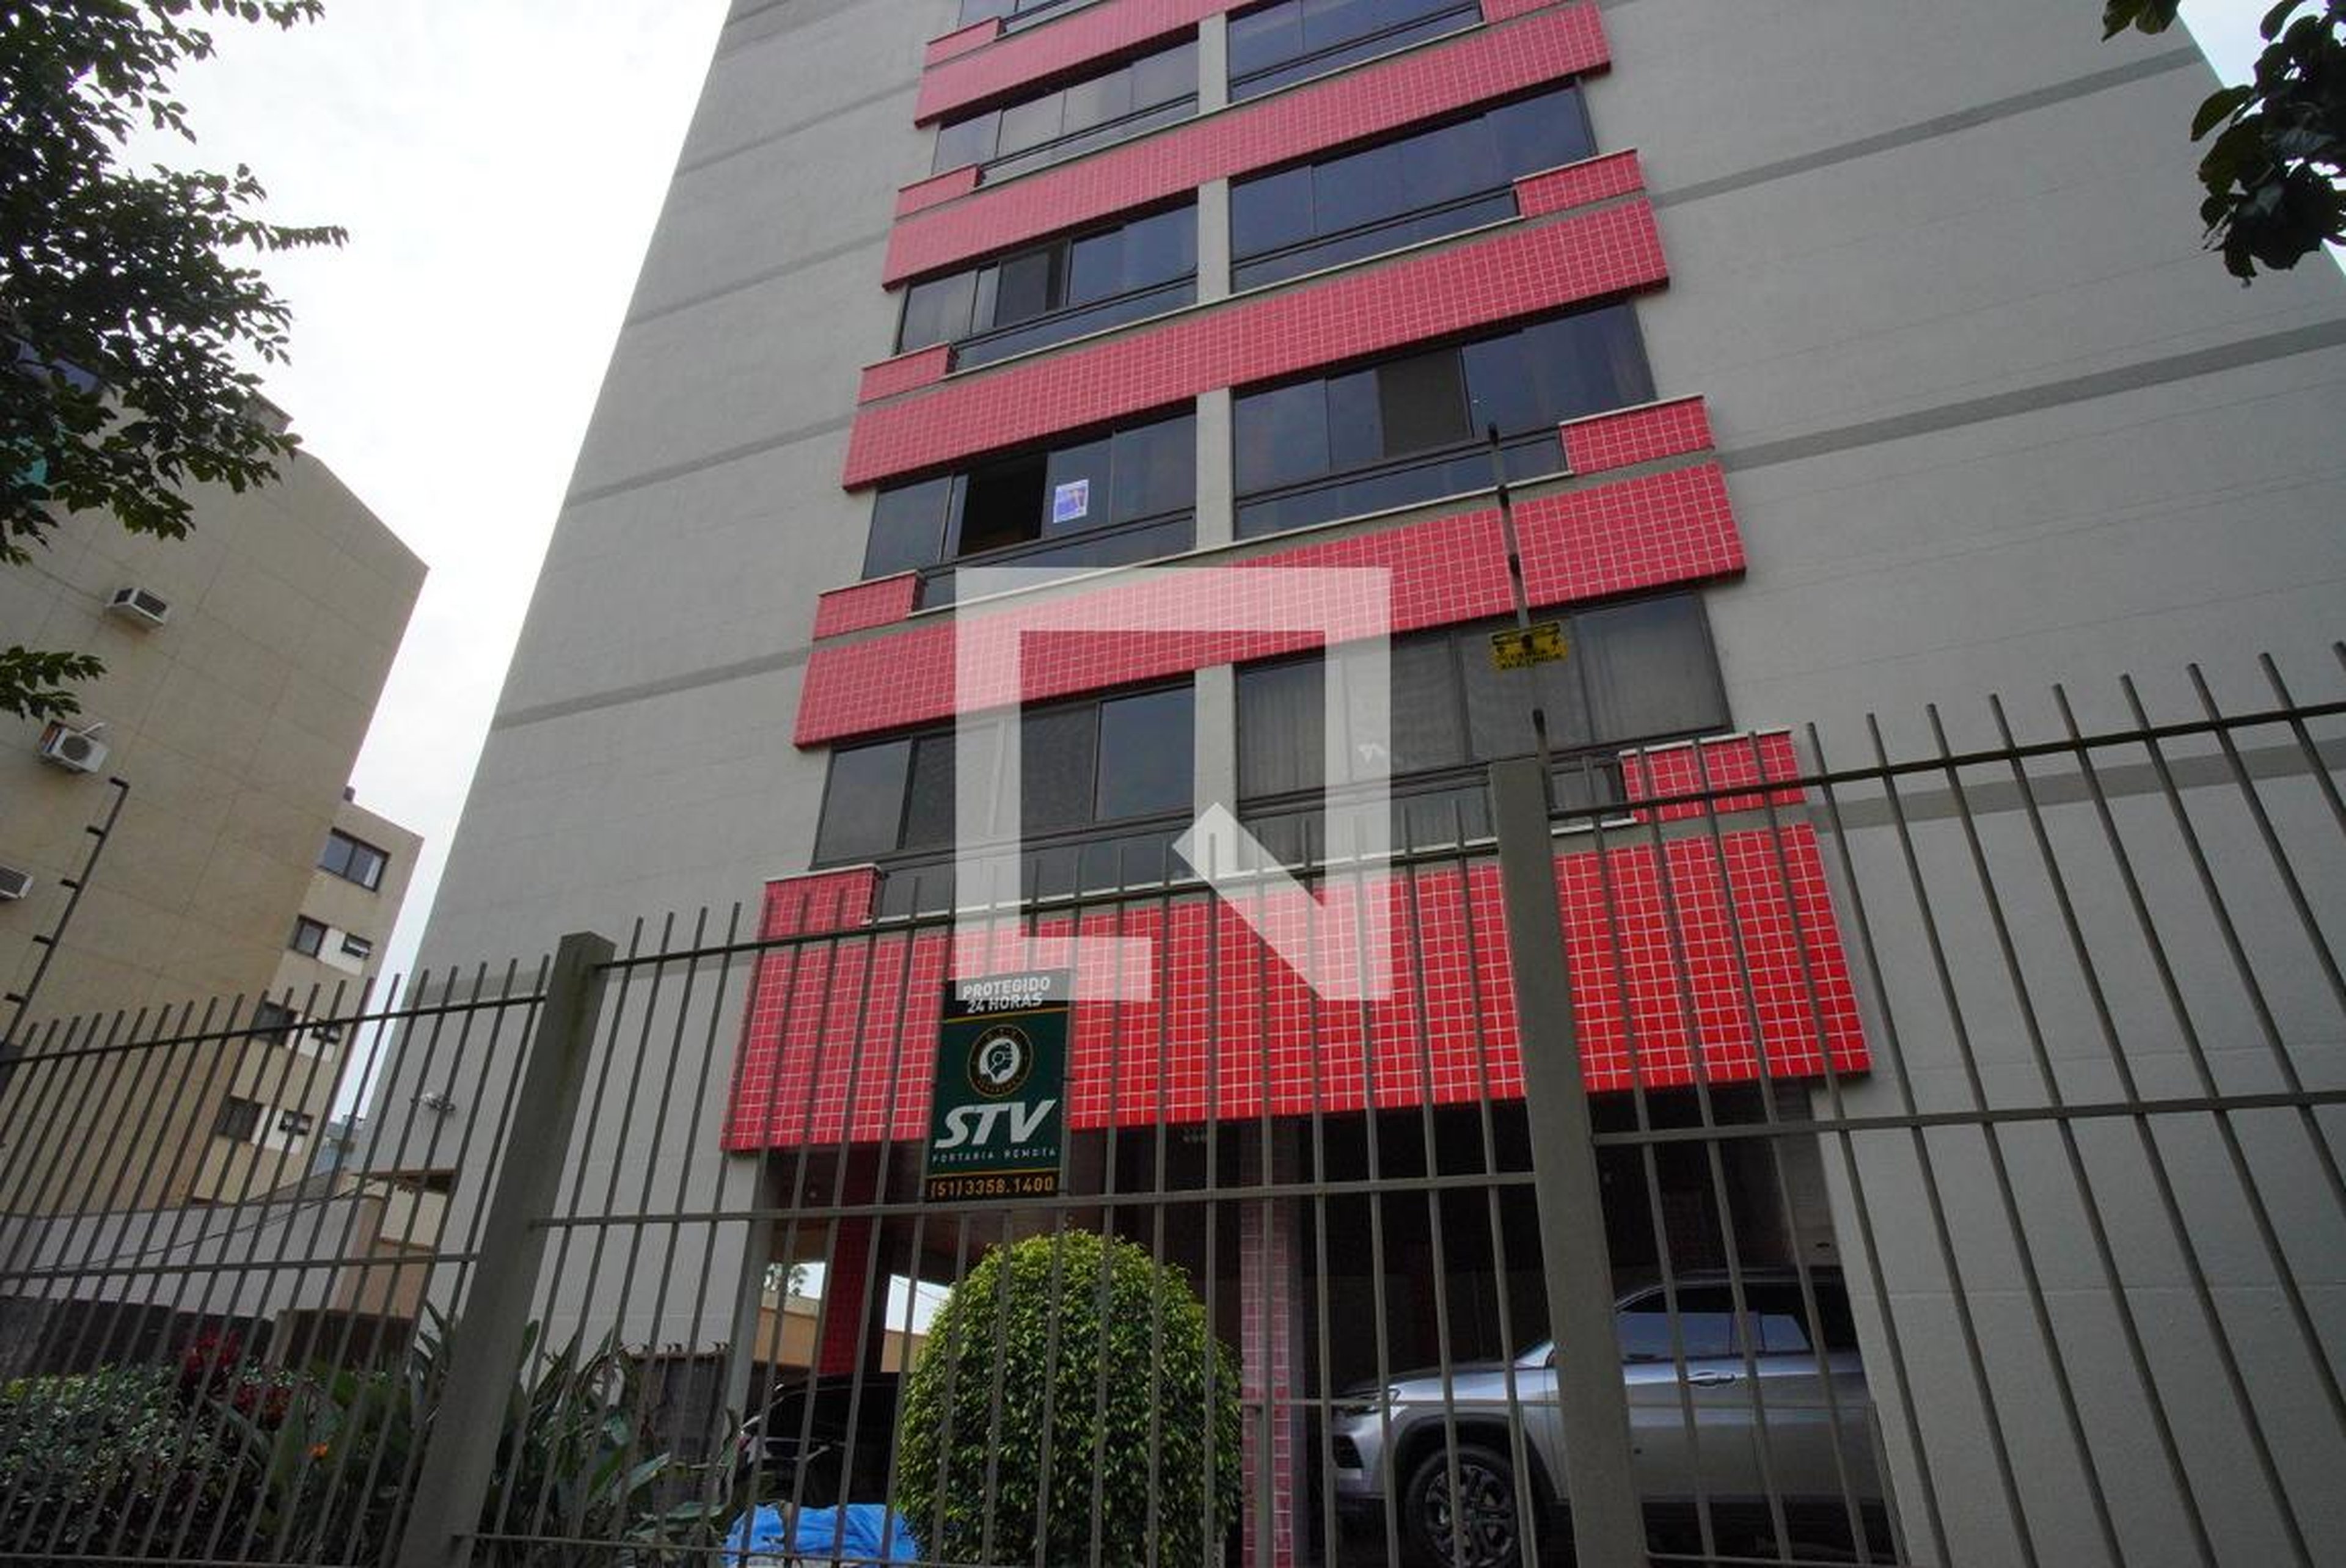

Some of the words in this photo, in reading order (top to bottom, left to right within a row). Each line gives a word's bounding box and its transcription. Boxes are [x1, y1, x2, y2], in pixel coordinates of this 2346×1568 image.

[962, 976, 1051, 1000] PROTEGIDO
[967, 999, 985, 1013] 24
[988, 992, 1043, 1011] HORAS
[934, 1099, 1057, 1149] STV
[932, 1151, 995, 1163] PORTARIA
